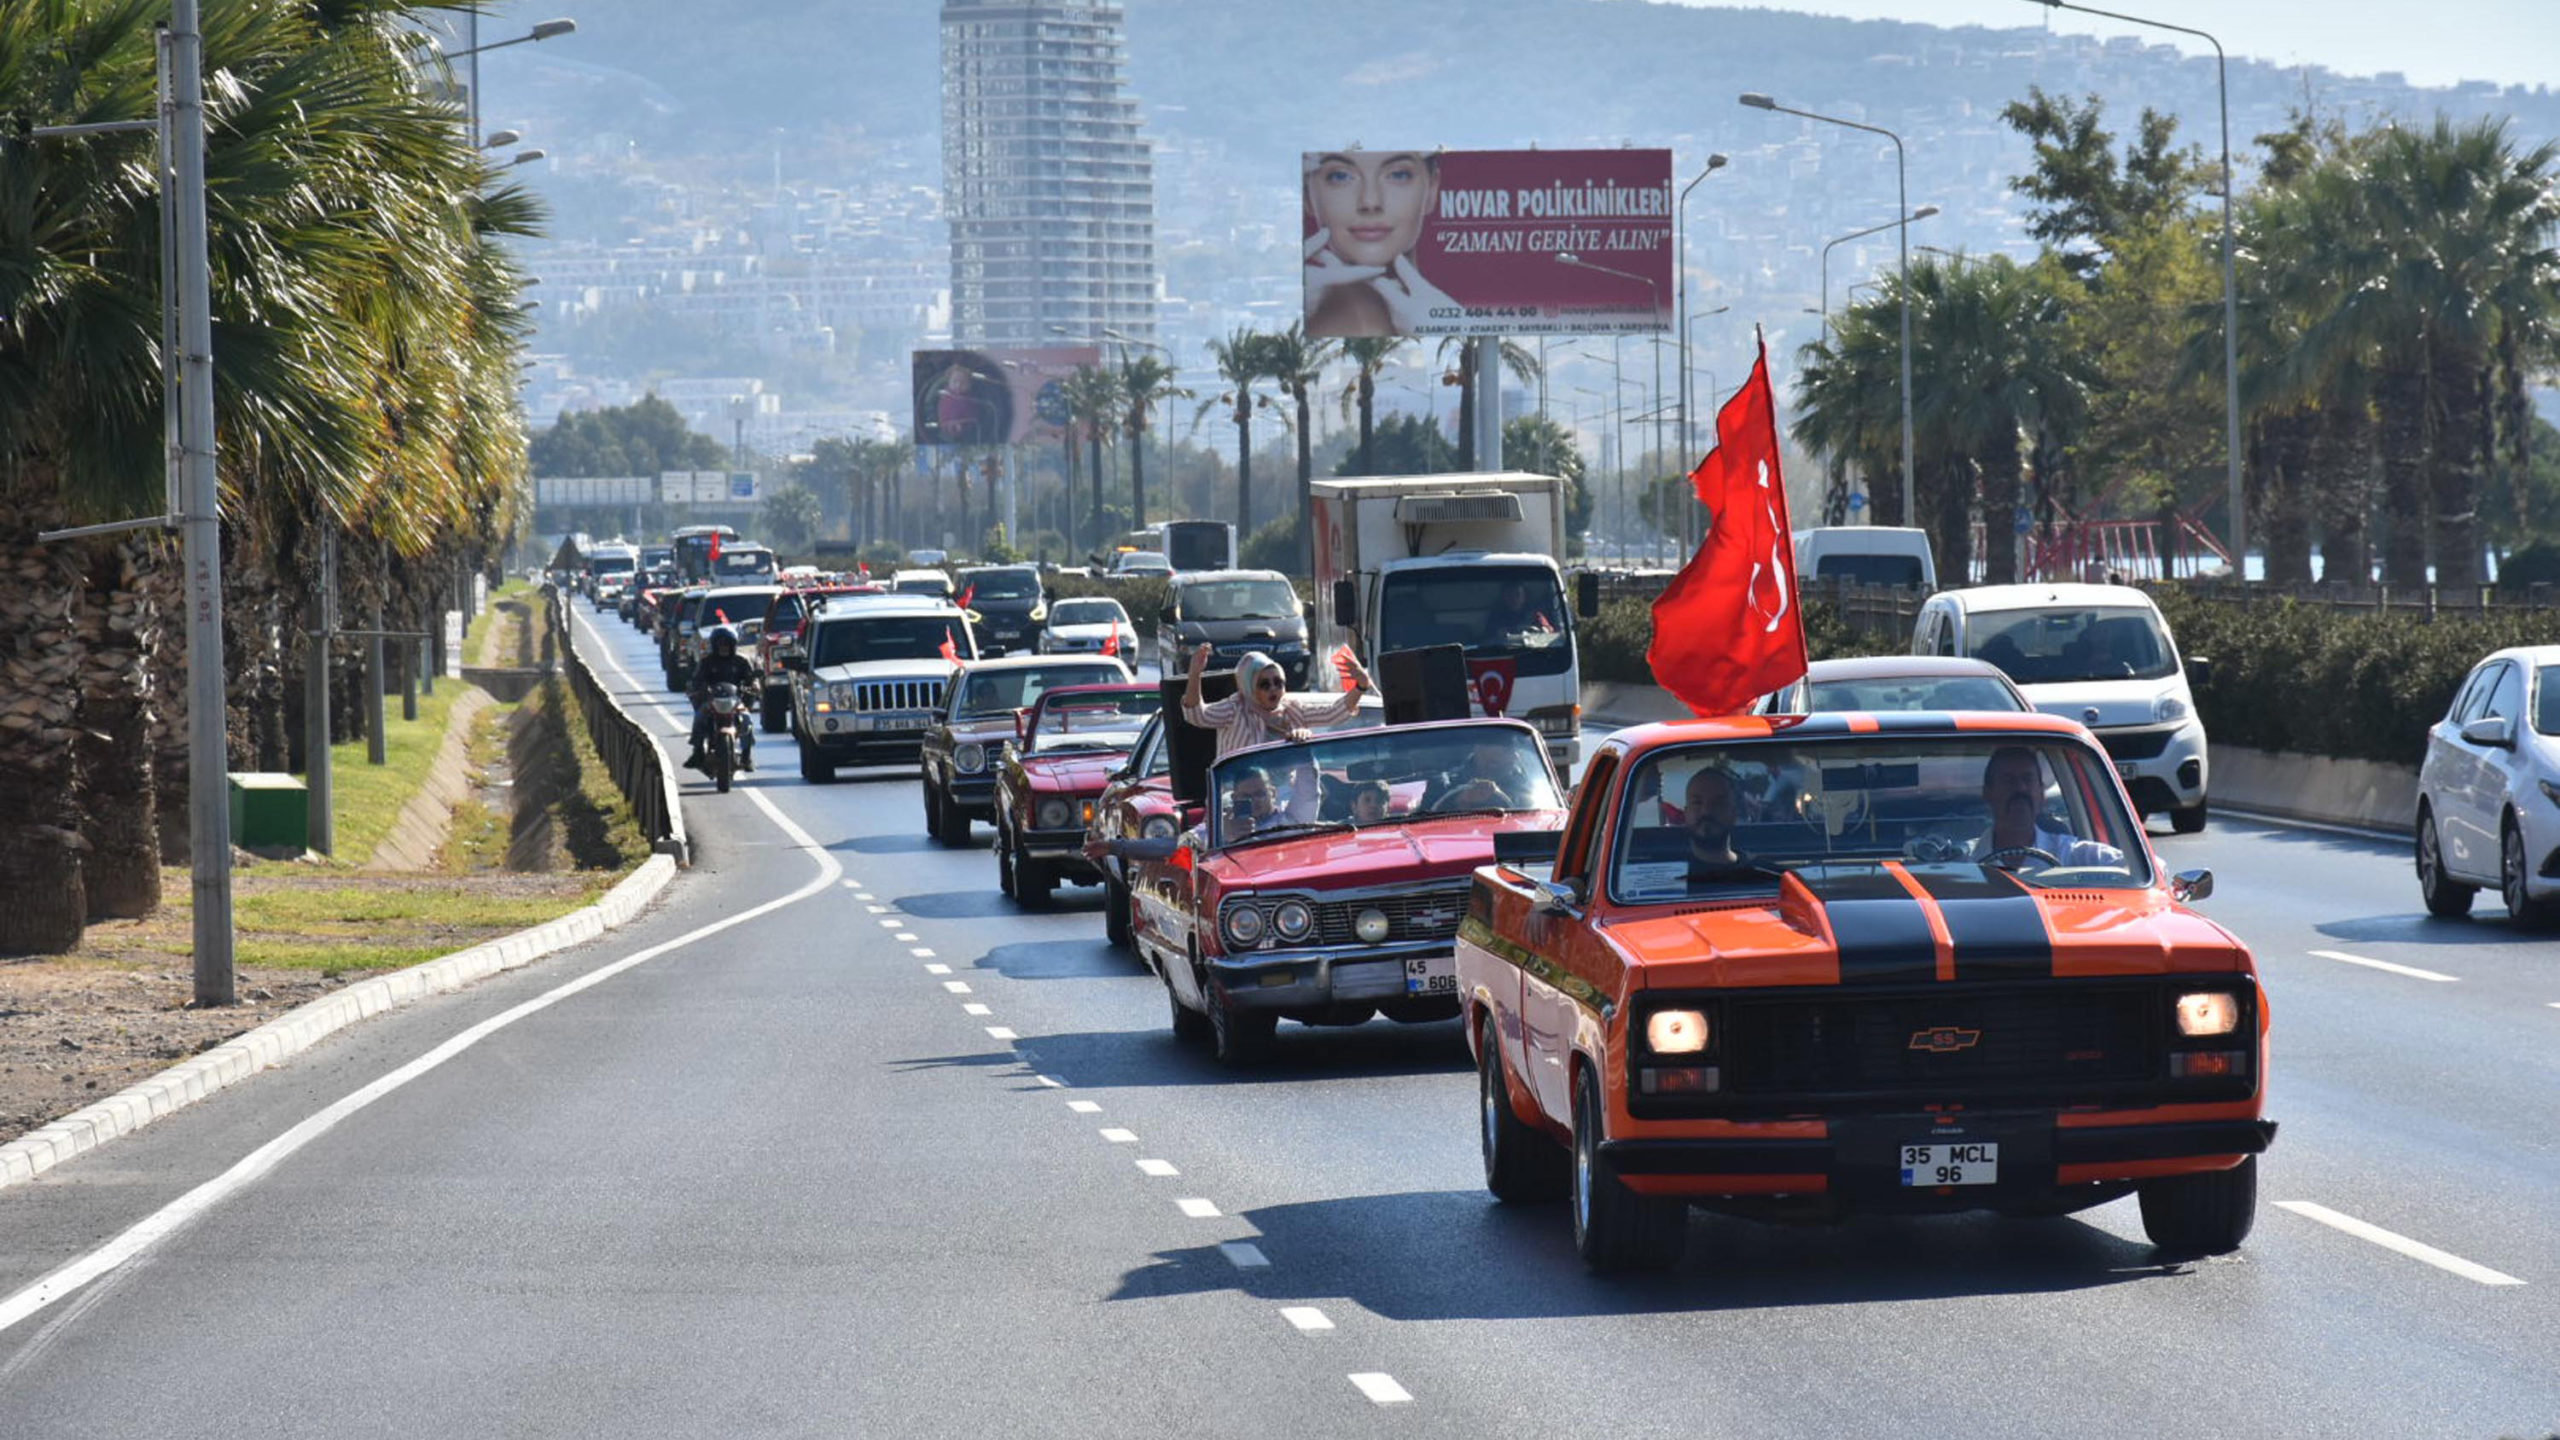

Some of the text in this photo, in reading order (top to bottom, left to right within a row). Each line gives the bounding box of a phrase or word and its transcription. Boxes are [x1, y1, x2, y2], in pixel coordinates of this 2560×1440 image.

[1440, 179, 1670, 218] NOVAR POLİKLİNİKLERİ
[1528, 224, 1600, 251] GERİYE
[1429, 307, 1537, 318] 0232 404 44 00
[1408, 961, 1426, 975] 45
[1429, 975, 1457, 989] 606
[1934, 1032, 1954, 1046] SS
[1904, 1145, 1994, 1165] 35 MCL
[1936, 1166, 1962, 1183] 96
